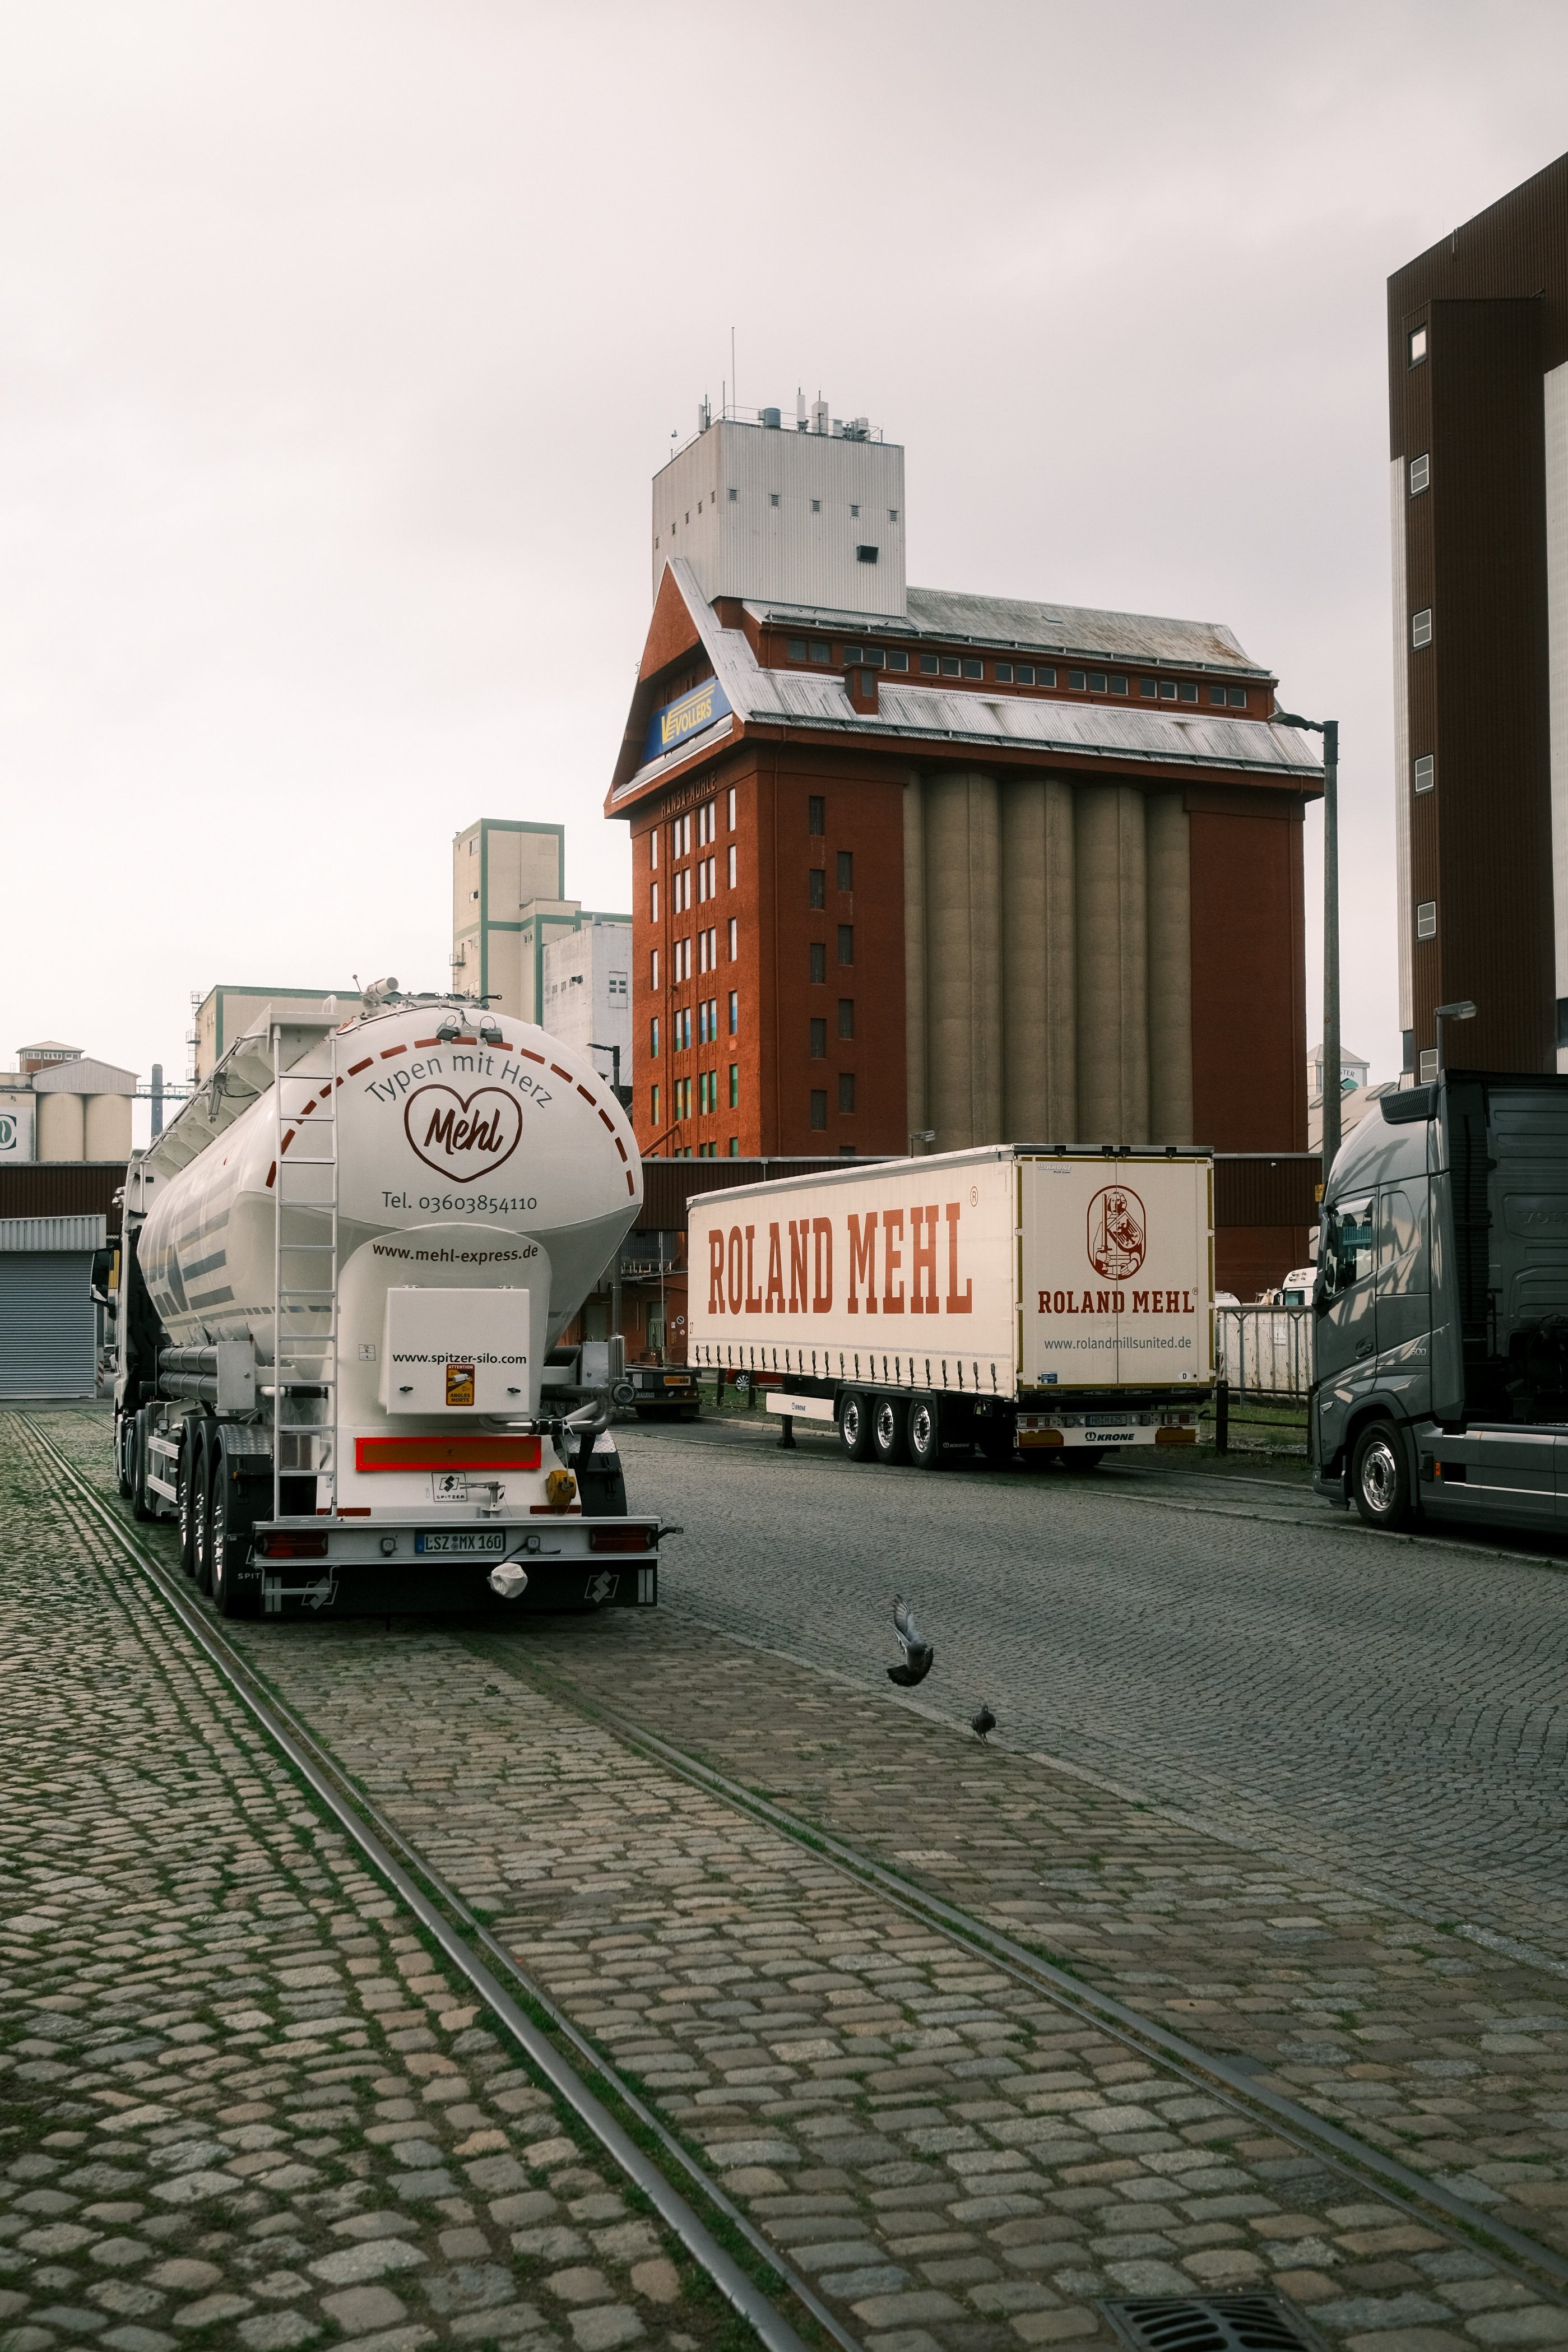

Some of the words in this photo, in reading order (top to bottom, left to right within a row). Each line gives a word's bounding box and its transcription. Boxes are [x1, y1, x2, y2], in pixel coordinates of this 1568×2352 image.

[676, 698, 711, 736] VOLLERS
[364, 1056, 442, 1103] Typen
[453, 1052, 494, 1075] mit
[500, 1059, 553, 1108] Herz
[424, 1108, 504, 1155] Mehl
[382, 1191, 411, 1209] Tel.
[419, 1195, 537, 1213] 03603854110
[373, 1244, 538, 1265] www.mehl-express.de
[708, 1217, 833, 1315] ROLAND
[847, 1202, 972, 1314] MEHL
[1038, 1291, 1125, 1314] ROLAND
[1132, 1290, 1194, 1313] MEHL
[1044, 1337, 1191, 1349] www.rolandmillsunited.de
[392, 1352, 527, 1365] www.spitzer-silo.com
[426, 1537, 449, 1550] LSZ
[460, 1536, 475, 1549] MX
[479, 1535, 501, 1548] 160
